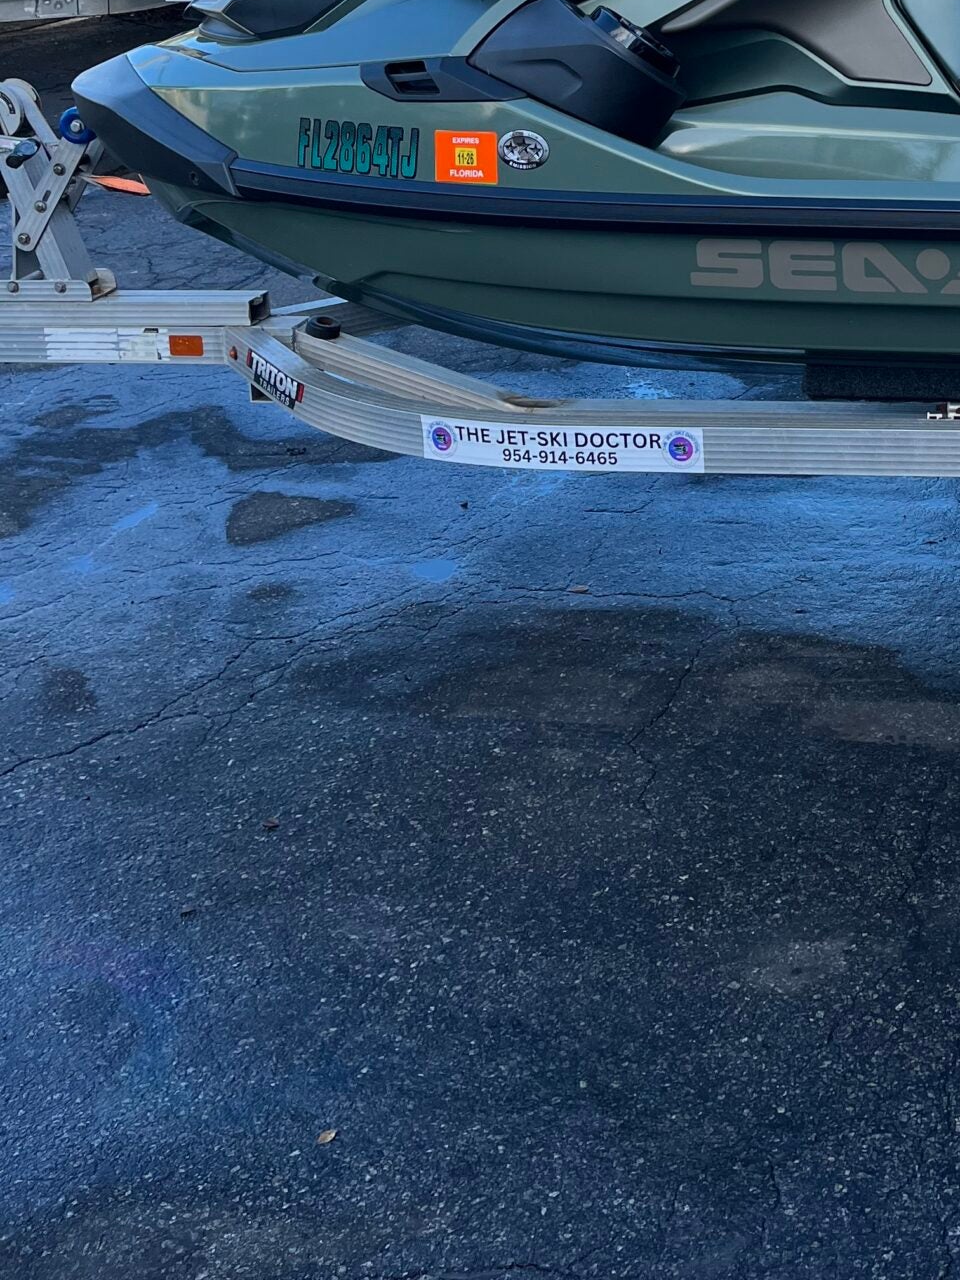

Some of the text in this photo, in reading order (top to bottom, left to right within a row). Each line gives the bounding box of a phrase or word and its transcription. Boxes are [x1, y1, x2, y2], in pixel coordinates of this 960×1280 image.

[297, 117, 420, 180] FL2864TJ
[452, 136, 480, 145] EXPIRES
[449, 168, 484, 178] FLORIDA
[251, 351, 298, 400] TRITON
[259, 377, 290, 406] TRAILERS
[455, 425, 491, 444] THE
[496, 429, 568, 448] JET-SKI
[574, 433, 662, 449] DOCTOR
[502, 448, 618, 465] 954-914-6465
